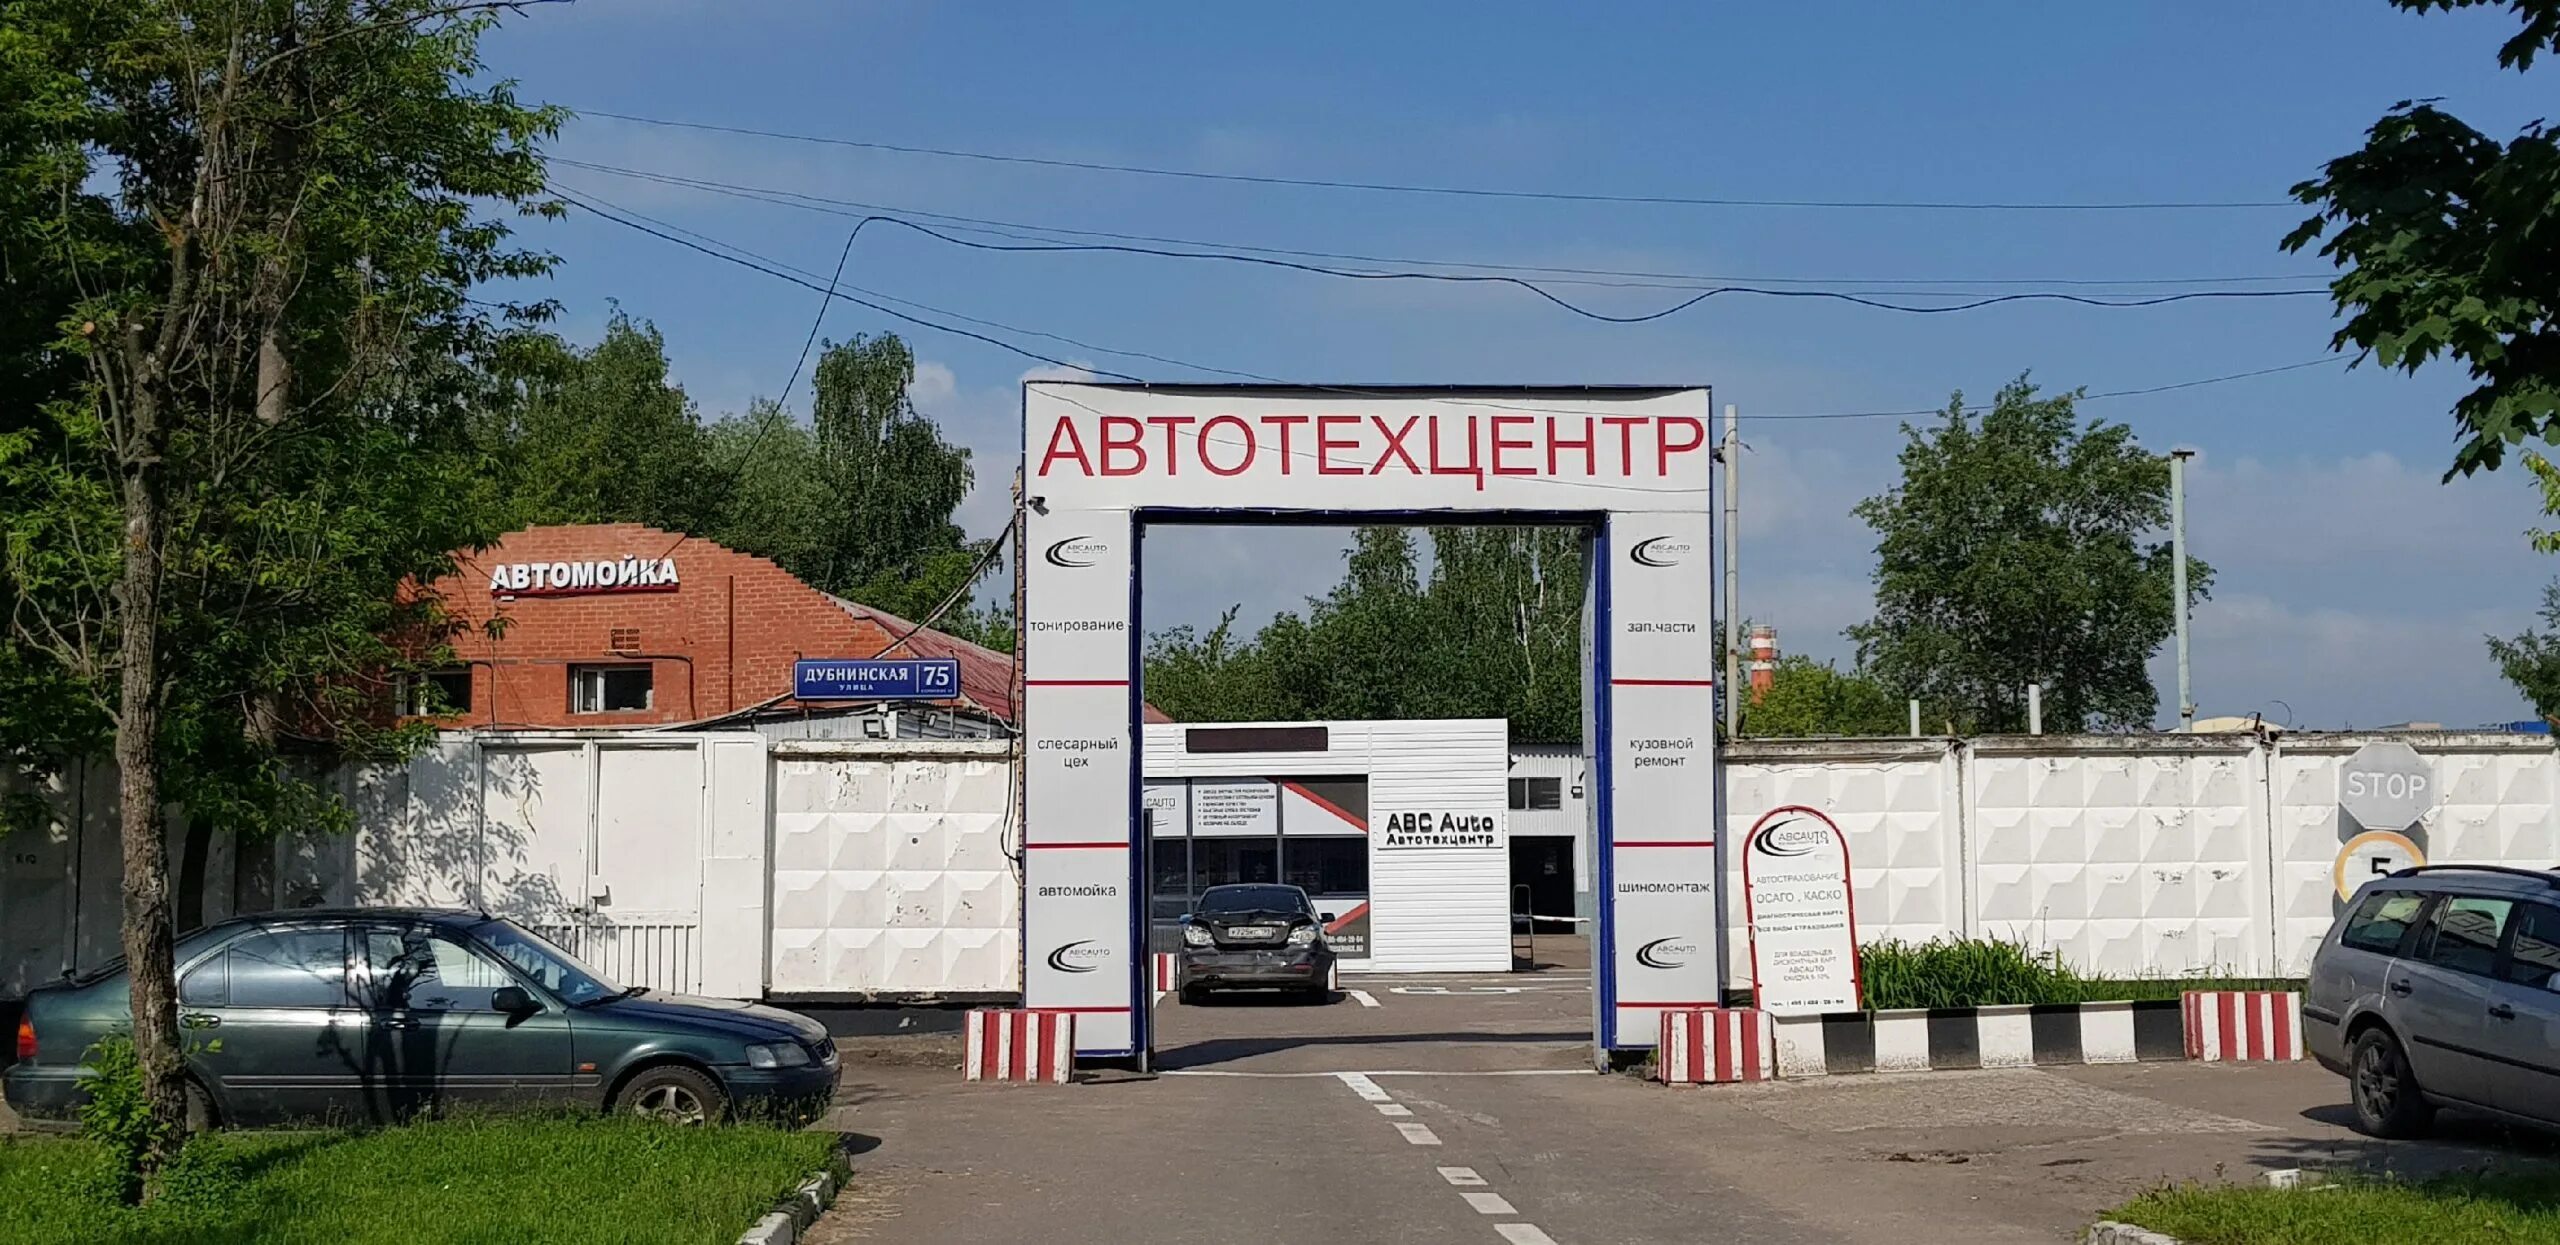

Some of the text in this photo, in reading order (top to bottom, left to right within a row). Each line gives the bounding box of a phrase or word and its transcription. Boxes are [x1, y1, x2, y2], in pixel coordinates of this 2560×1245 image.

[1038, 415, 1704, 491] АВТОТЕХЦЕНТР
[490, 554, 679, 590] АВТОМОЙКА
[1030, 621, 1124, 633] тонирование
[1627, 622, 1696, 633] зап.части
[804, 666, 950, 686] ДУБНИНСКАЯ 75
[1037, 737, 1118, 751] слесарный
[1630, 737, 1693, 751] кузовной
[1064, 757, 1089, 768] цех
[1634, 757, 1686, 768] ремонт
[2347, 771, 2427, 799] STOP
[1386, 812, 1494, 833] ABC Auto
[1386, 833, 1494, 847] Автотехцентр
[1778, 830, 1829, 842] ABCAUTO
[2371, 856, 2391, 877] 5
[1756, 872, 1840, 884] АВТОСТРАХОВАНИЕ
[1038, 883, 1117, 897] автомойка
[1618, 882, 1710, 893] шиномонтаж
[1756, 892, 1794, 904] ОСАГО
[1804, 889, 1842, 901] КАСКО
